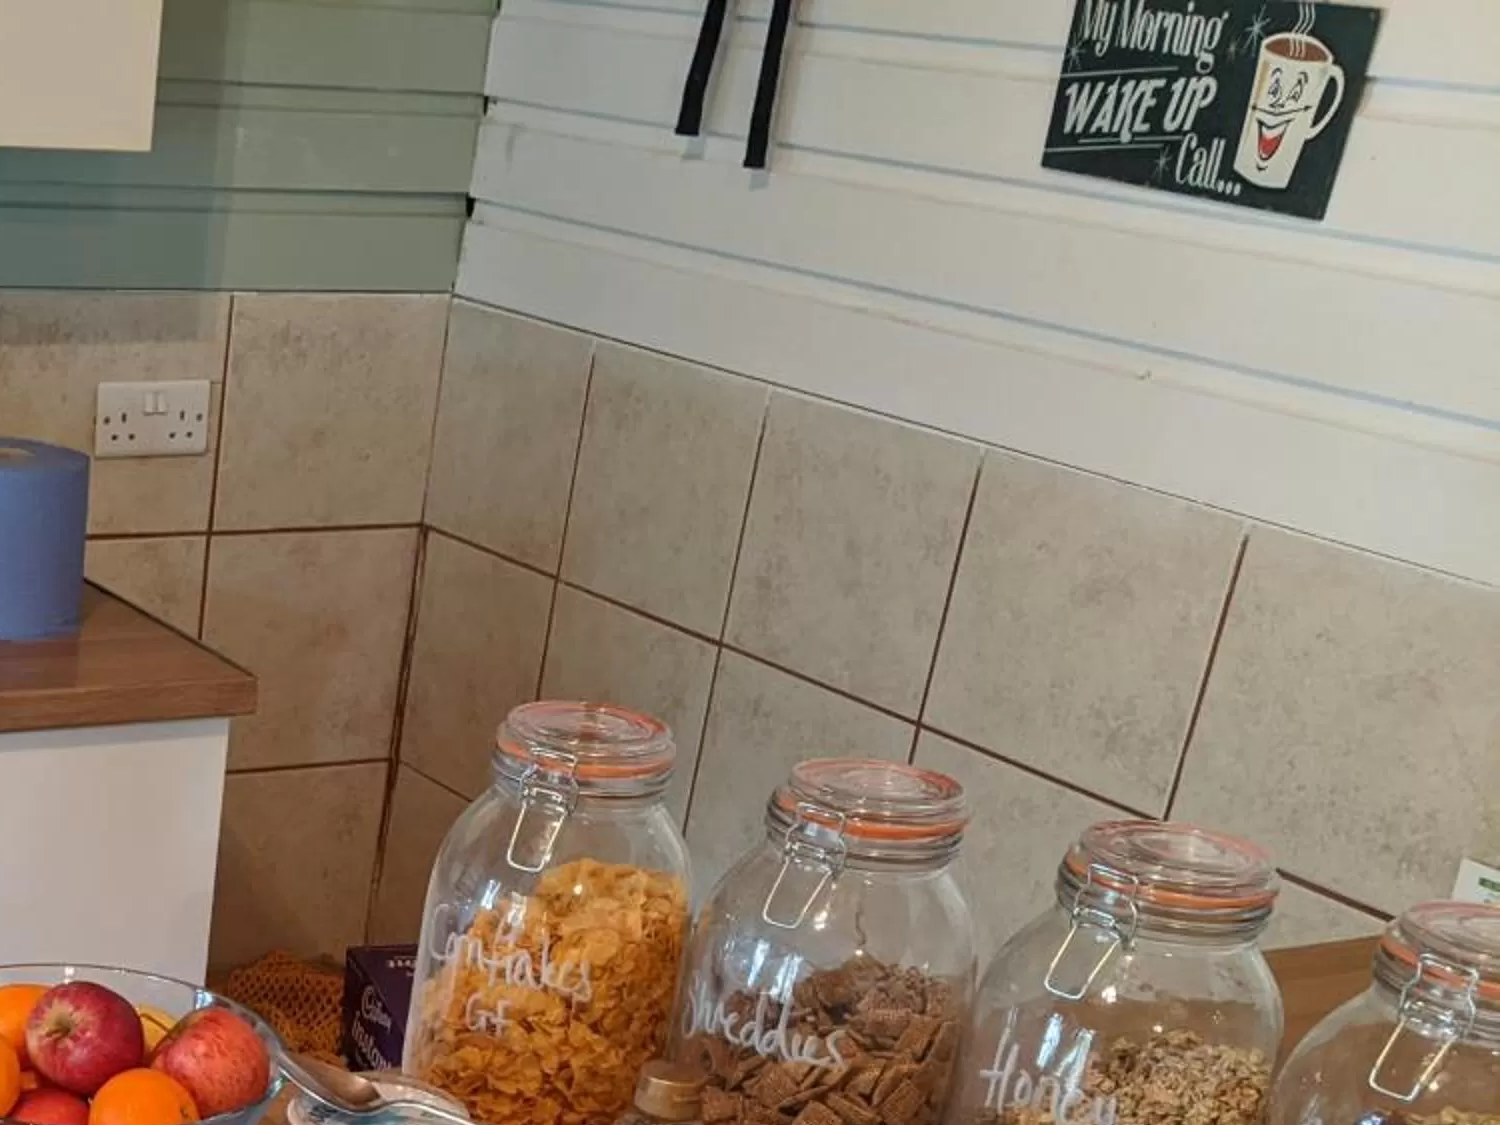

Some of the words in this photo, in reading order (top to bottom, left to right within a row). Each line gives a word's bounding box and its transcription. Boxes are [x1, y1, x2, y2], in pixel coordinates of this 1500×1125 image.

[1079, 0, 1118, 57] My
[1116, 0, 1230, 74] Morning
[1064, 76, 1168, 144] WAKE
[1163, 75, 1219, 132] UP
